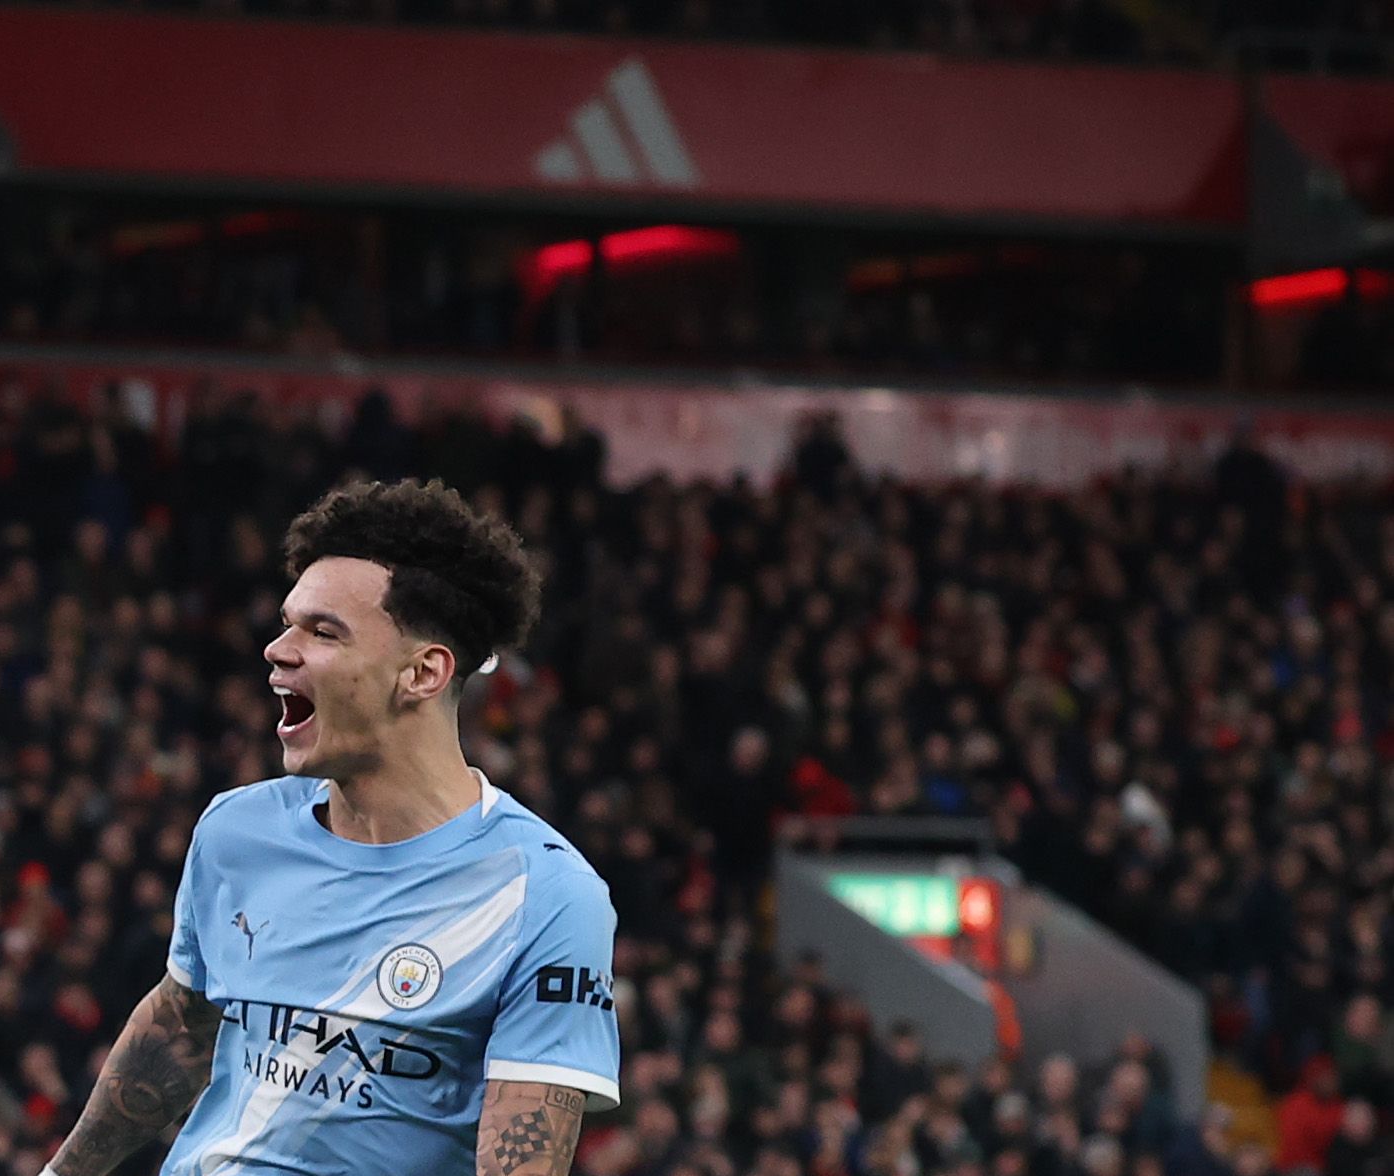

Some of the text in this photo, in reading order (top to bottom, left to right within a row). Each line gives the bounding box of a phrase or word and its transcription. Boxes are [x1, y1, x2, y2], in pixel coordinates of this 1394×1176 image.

[388, 948, 438, 976] MANCHESTER
[391, 996, 411, 1007] CITY
[222, 1000, 442, 1080] TIHAD
[243, 1047, 374, 1110] AIRWAYS
